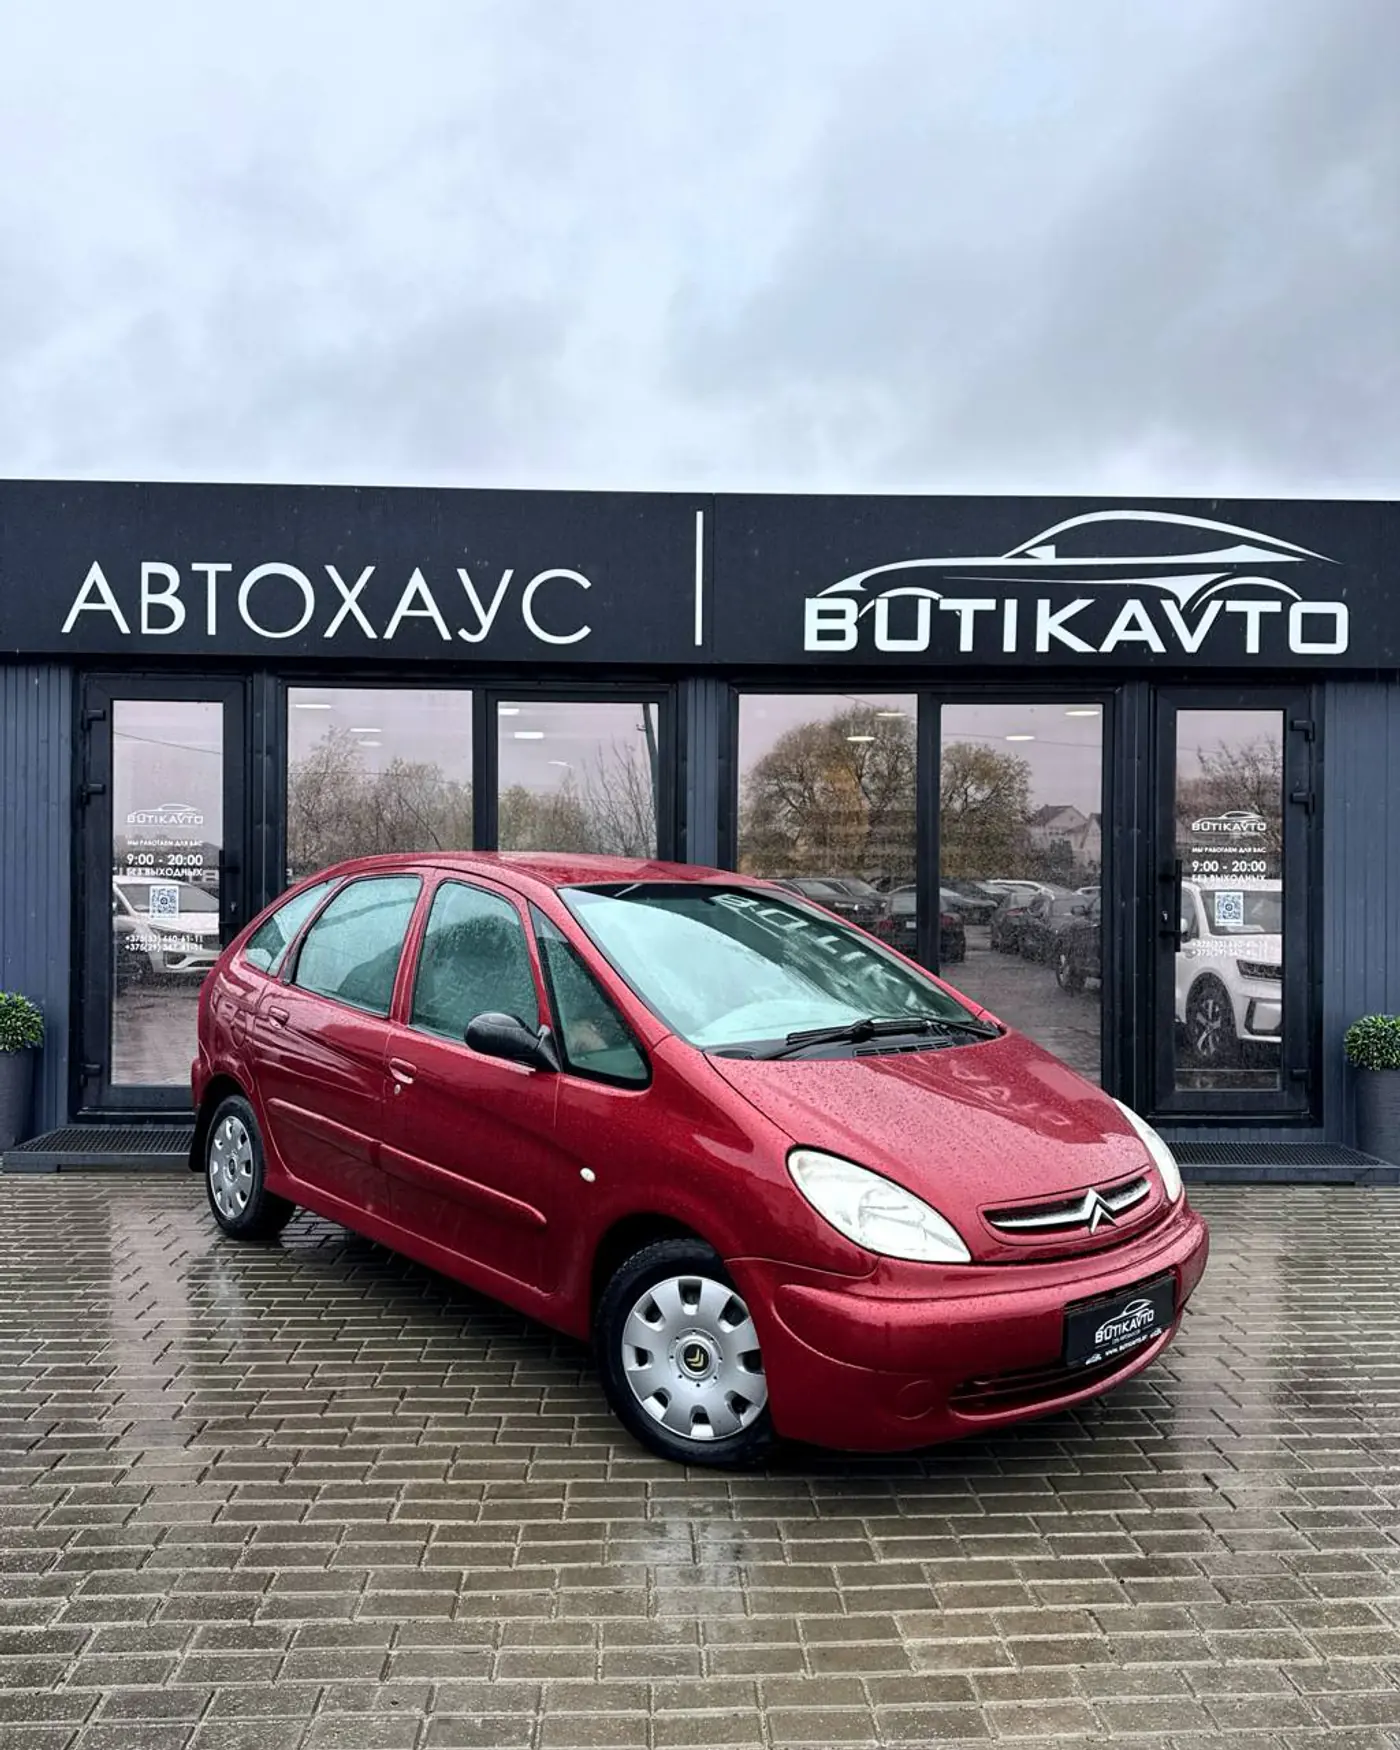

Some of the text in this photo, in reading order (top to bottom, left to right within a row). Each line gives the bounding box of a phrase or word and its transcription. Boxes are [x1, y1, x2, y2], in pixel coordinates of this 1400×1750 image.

[61, 560, 591, 645] АВТОХАУС
[804, 596, 1349, 654] BUTIKAVTO
[127, 813, 203, 825] BUTIKAVTO
[1191, 822, 1267, 831] BUTIKAVTO
[1204, 846, 1238, 854] РАБОТАЕМ
[1253, 846, 1267, 854] ВАС
[127, 853, 154, 866] 9:00
[167, 854, 203, 867] 20:00
[1192, 860, 1219, 873] 9:00
[1231, 860, 1267, 873] 20:00
[144, 867, 203, 878] ВЫХОДНЫХ
[1095, 1309, 1154, 1344] BUTIKAVTO
